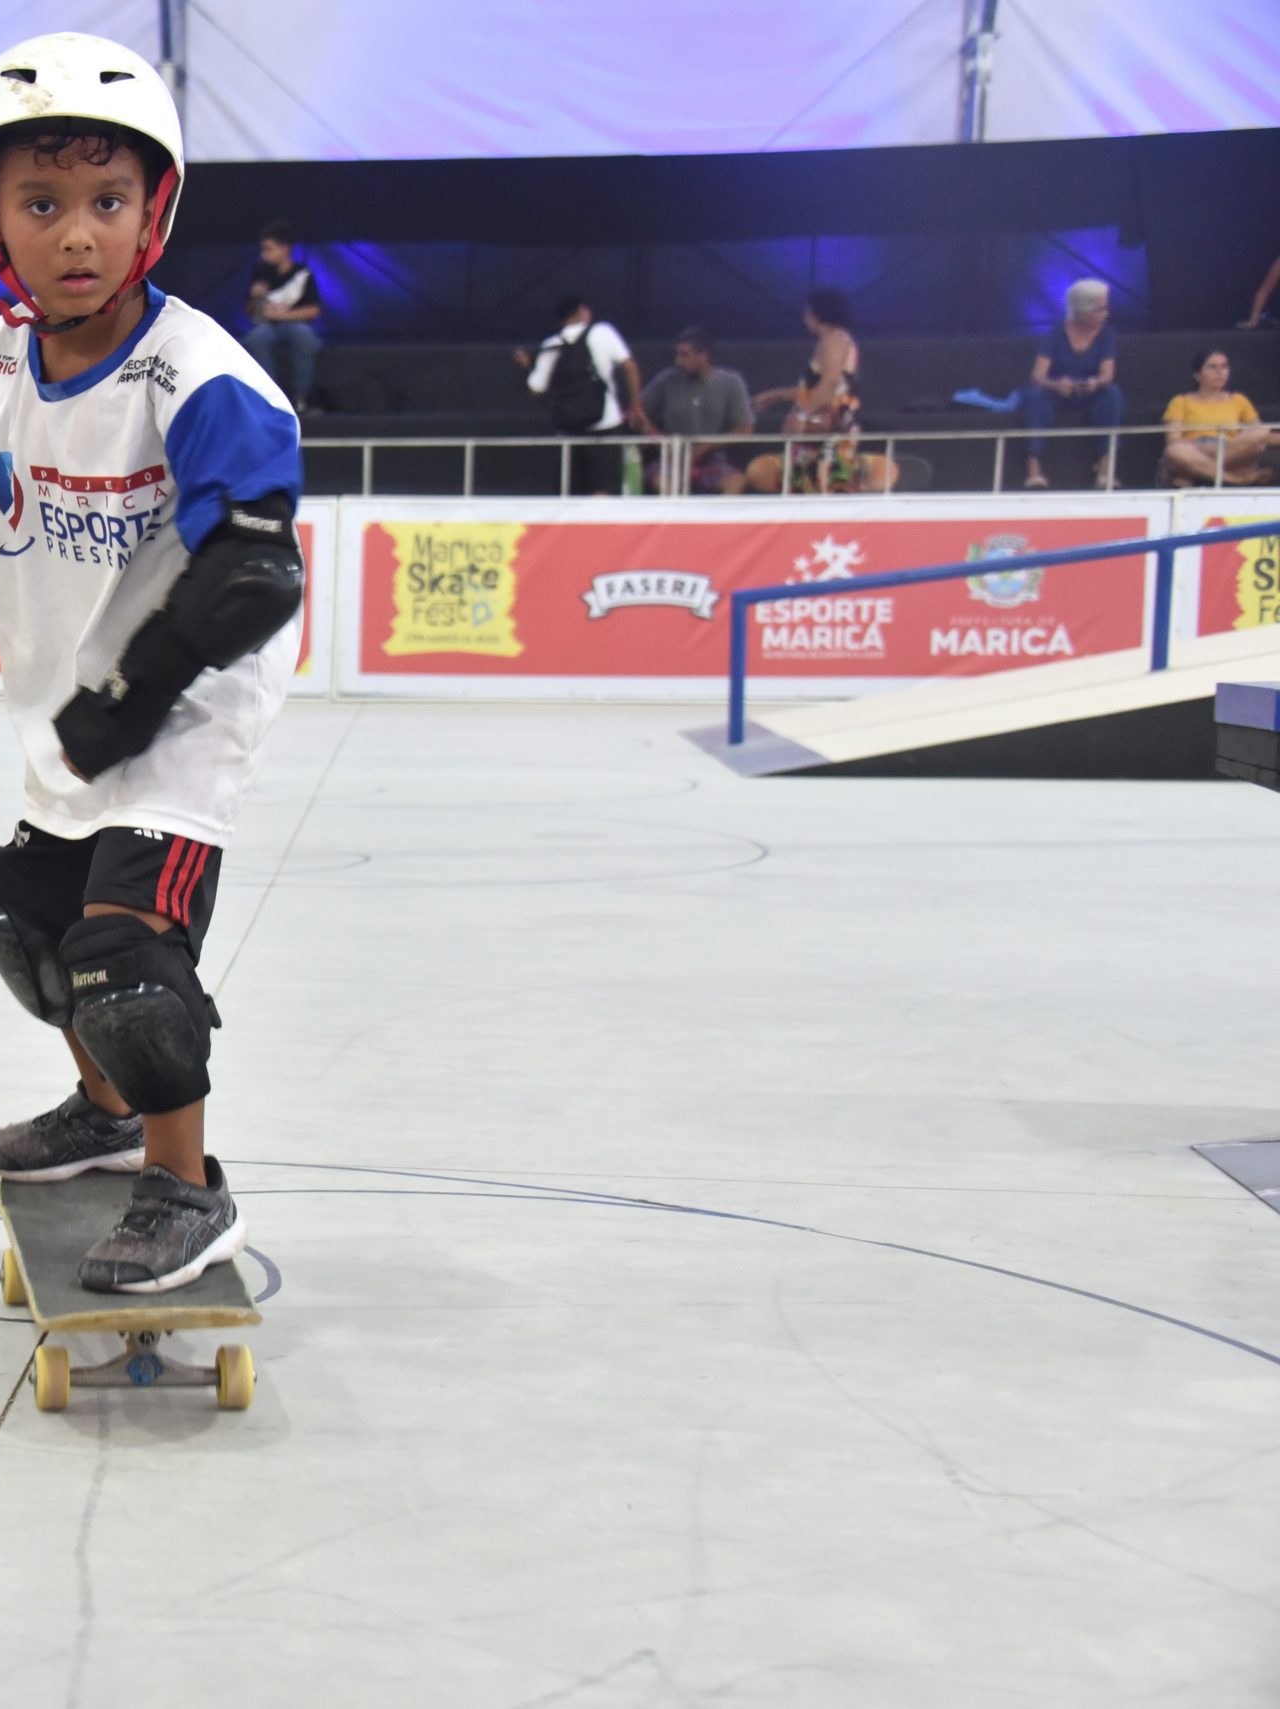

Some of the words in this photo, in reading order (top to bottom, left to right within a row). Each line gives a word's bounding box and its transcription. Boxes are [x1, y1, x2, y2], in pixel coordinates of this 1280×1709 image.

[40, 470, 152, 490] POJETO
[407, 562, 499, 595] Skate
[412, 596, 468, 627] Fest
[754, 597, 894, 623] ESPORTE
[930, 622, 1074, 656] MARICÁ
